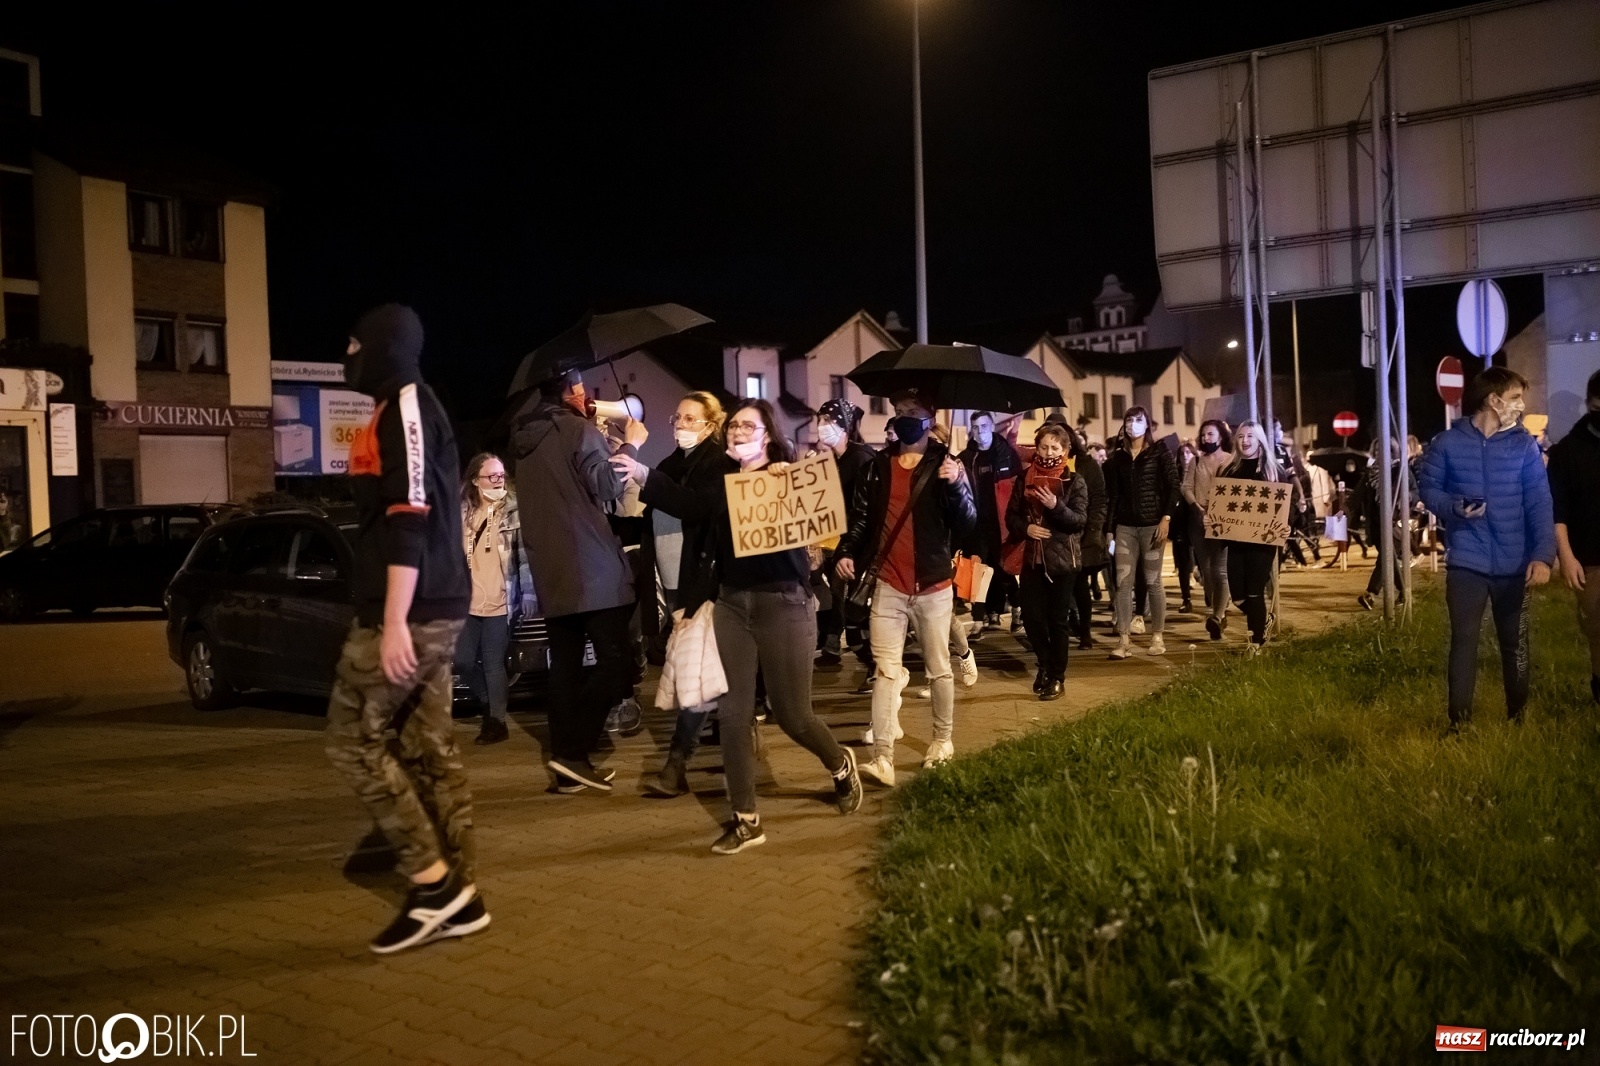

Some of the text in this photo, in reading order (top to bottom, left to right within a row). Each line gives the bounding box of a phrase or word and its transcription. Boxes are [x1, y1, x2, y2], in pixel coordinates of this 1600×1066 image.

[121, 404, 235, 427] CUKIERNIA
[407, 420, 420, 458] NIGHT
[734, 458, 829, 500] TO JEST
[736, 489, 828, 525] WOJNA Z
[738, 510, 838, 551] KOBIETAMI
